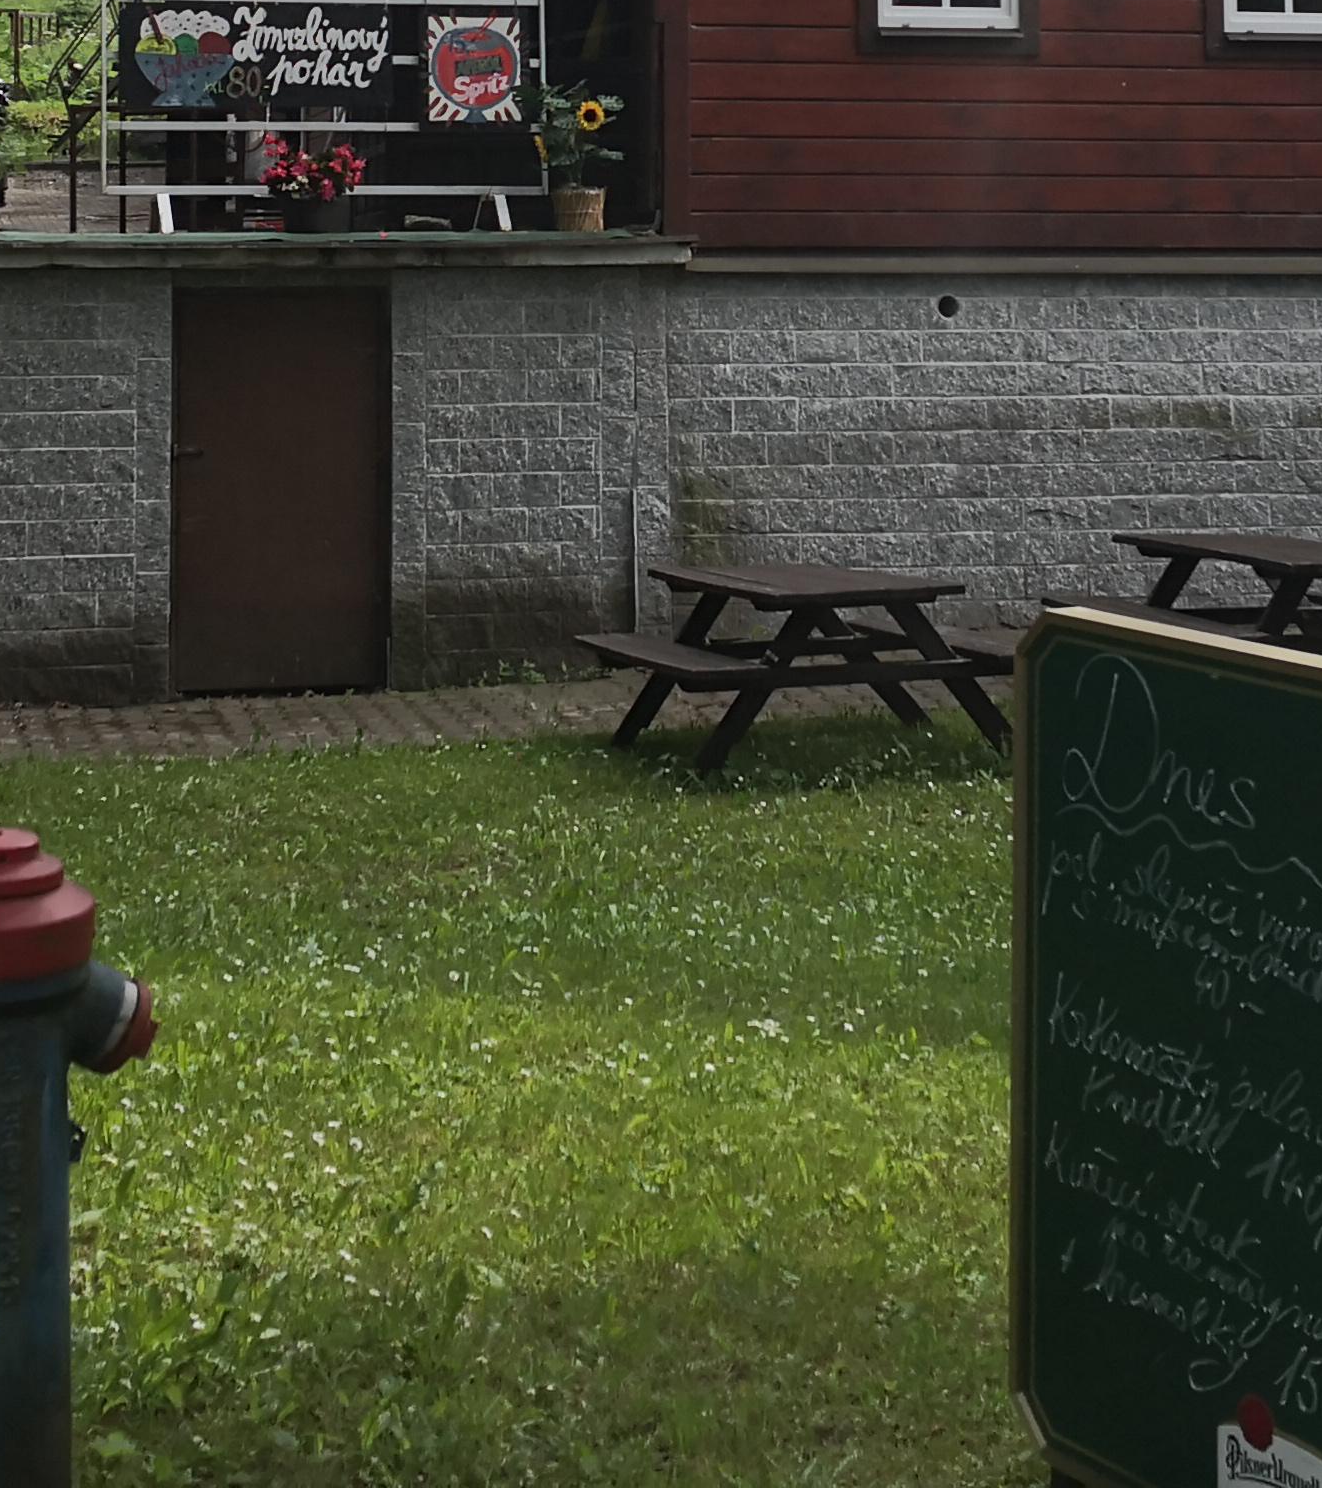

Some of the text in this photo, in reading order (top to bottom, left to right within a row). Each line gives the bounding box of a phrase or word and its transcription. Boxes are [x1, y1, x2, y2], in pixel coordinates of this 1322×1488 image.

[233, 6, 389, 71] Zmrzlinový
[267, 51, 370, 95] pohár
[1062, 654, 1256, 830] Dnes
[1226, 1434, 1272, 1480] Pilsner
